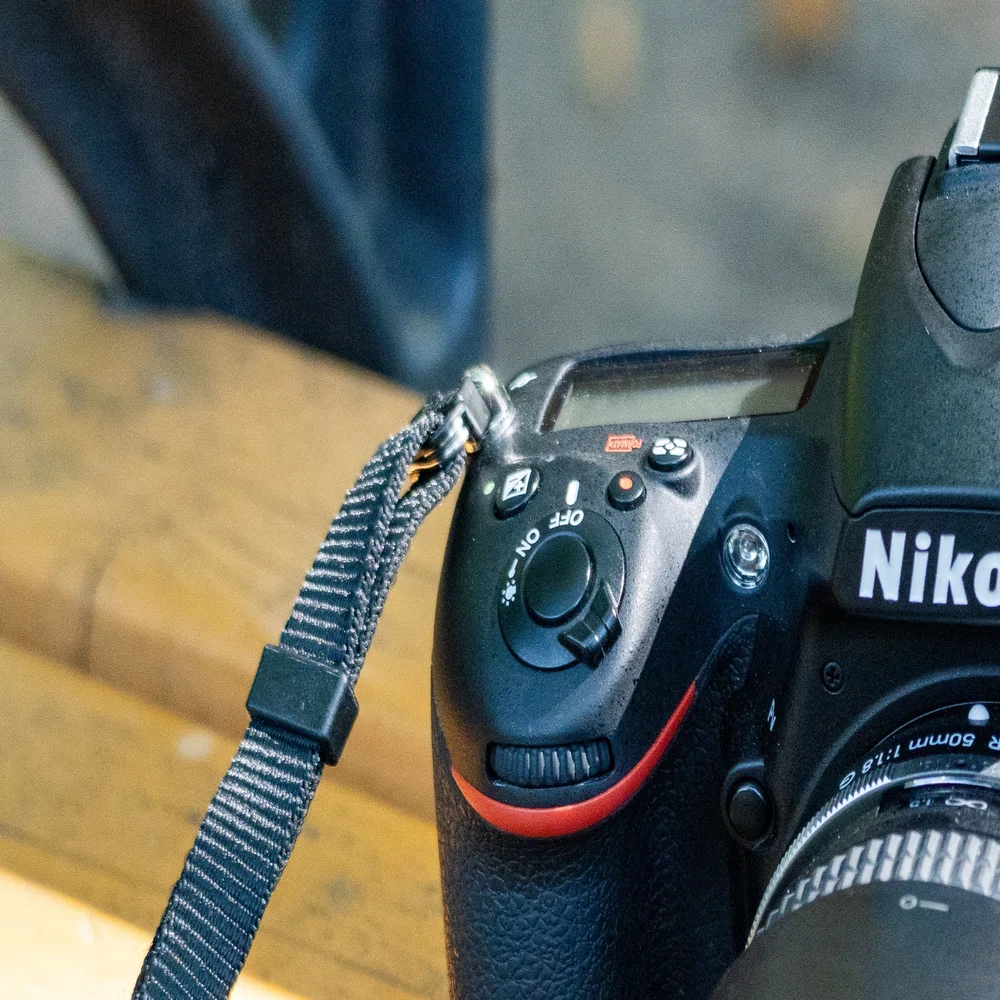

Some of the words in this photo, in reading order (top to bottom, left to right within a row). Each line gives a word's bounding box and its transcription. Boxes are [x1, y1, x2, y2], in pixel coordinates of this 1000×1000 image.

[549, 509, 584, 529] OFF
[515, 528, 541, 557] ON
[908, 733, 976, 751] 50mm
